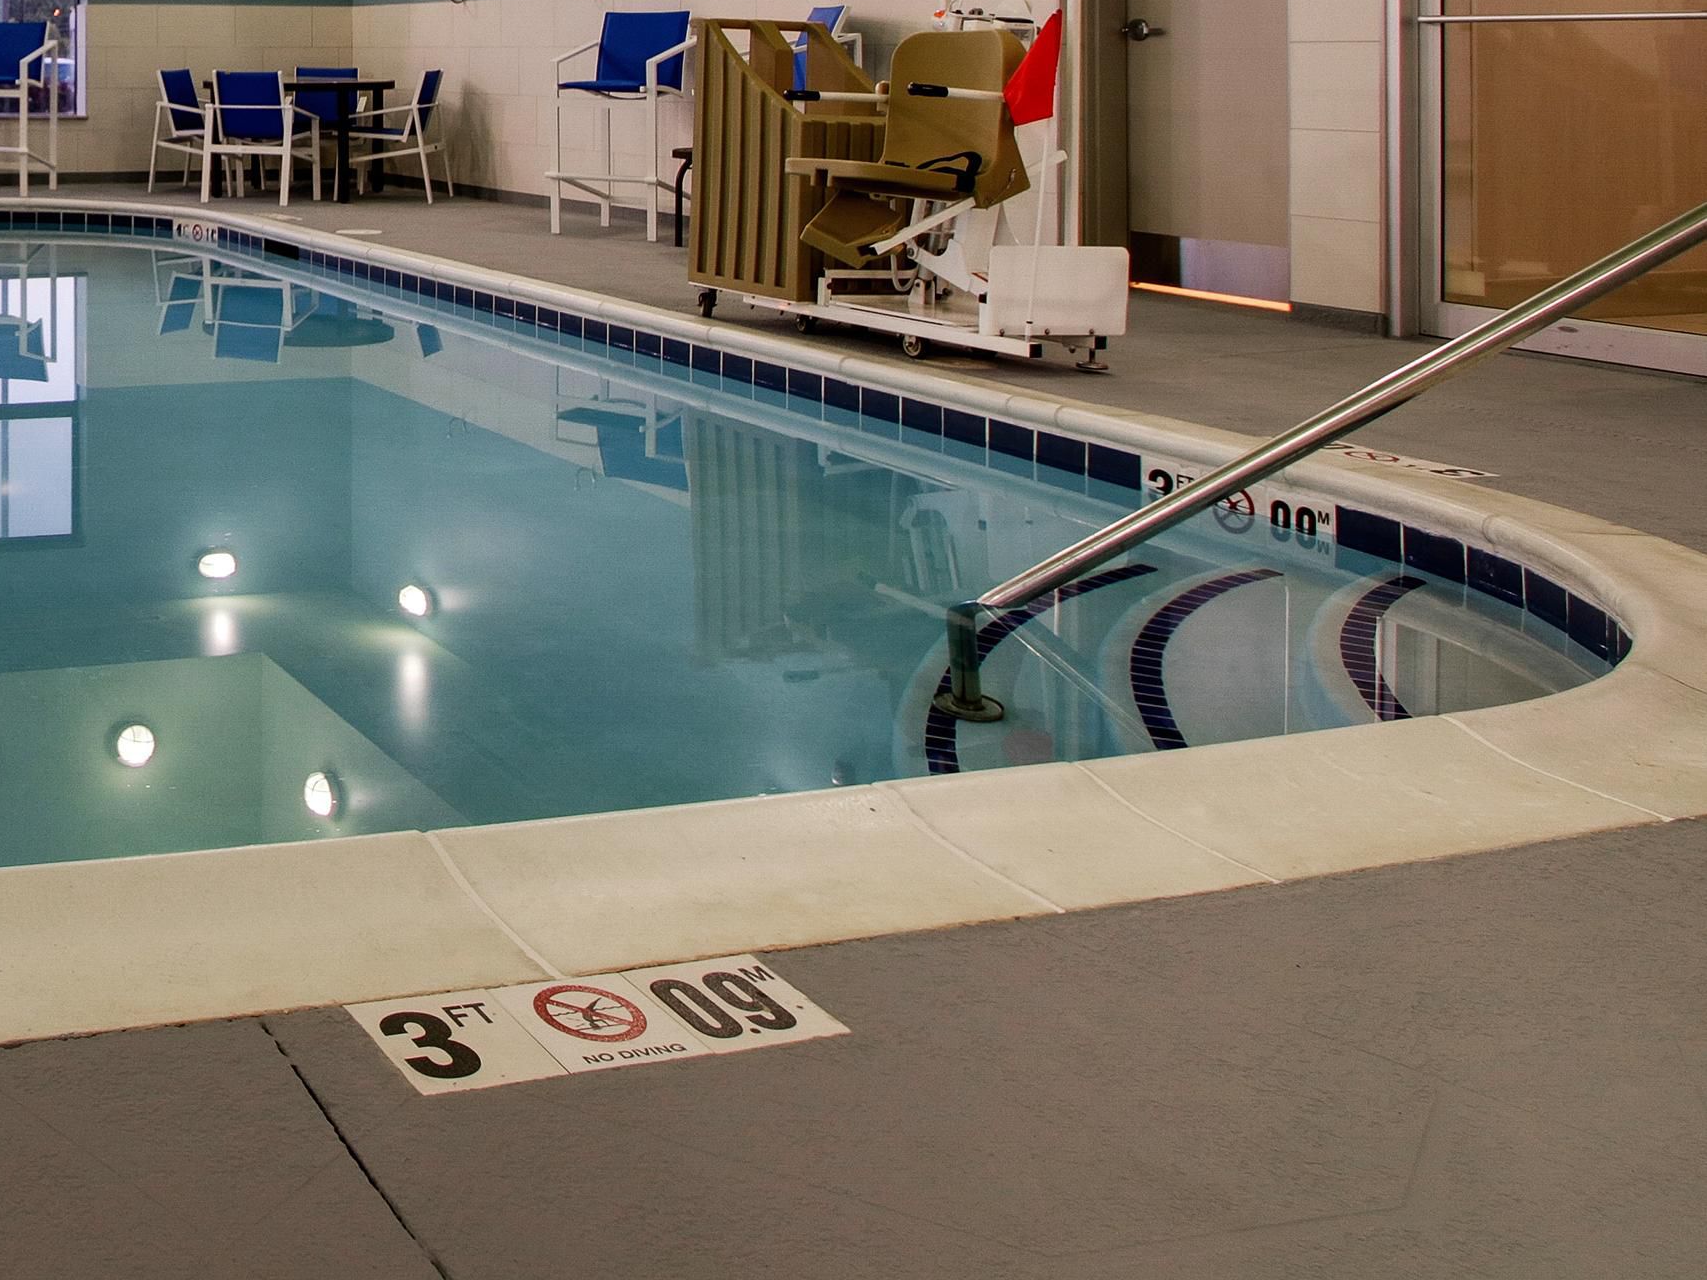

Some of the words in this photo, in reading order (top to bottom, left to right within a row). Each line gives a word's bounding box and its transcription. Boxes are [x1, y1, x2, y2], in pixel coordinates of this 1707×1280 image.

[379, 1011, 482, 1079] 3
[441, 1002, 494, 1028] FT
[736, 965, 776, 983] M
[582, 1052, 615, 1065] NO
[617, 1043, 688, 1060] DIVING
